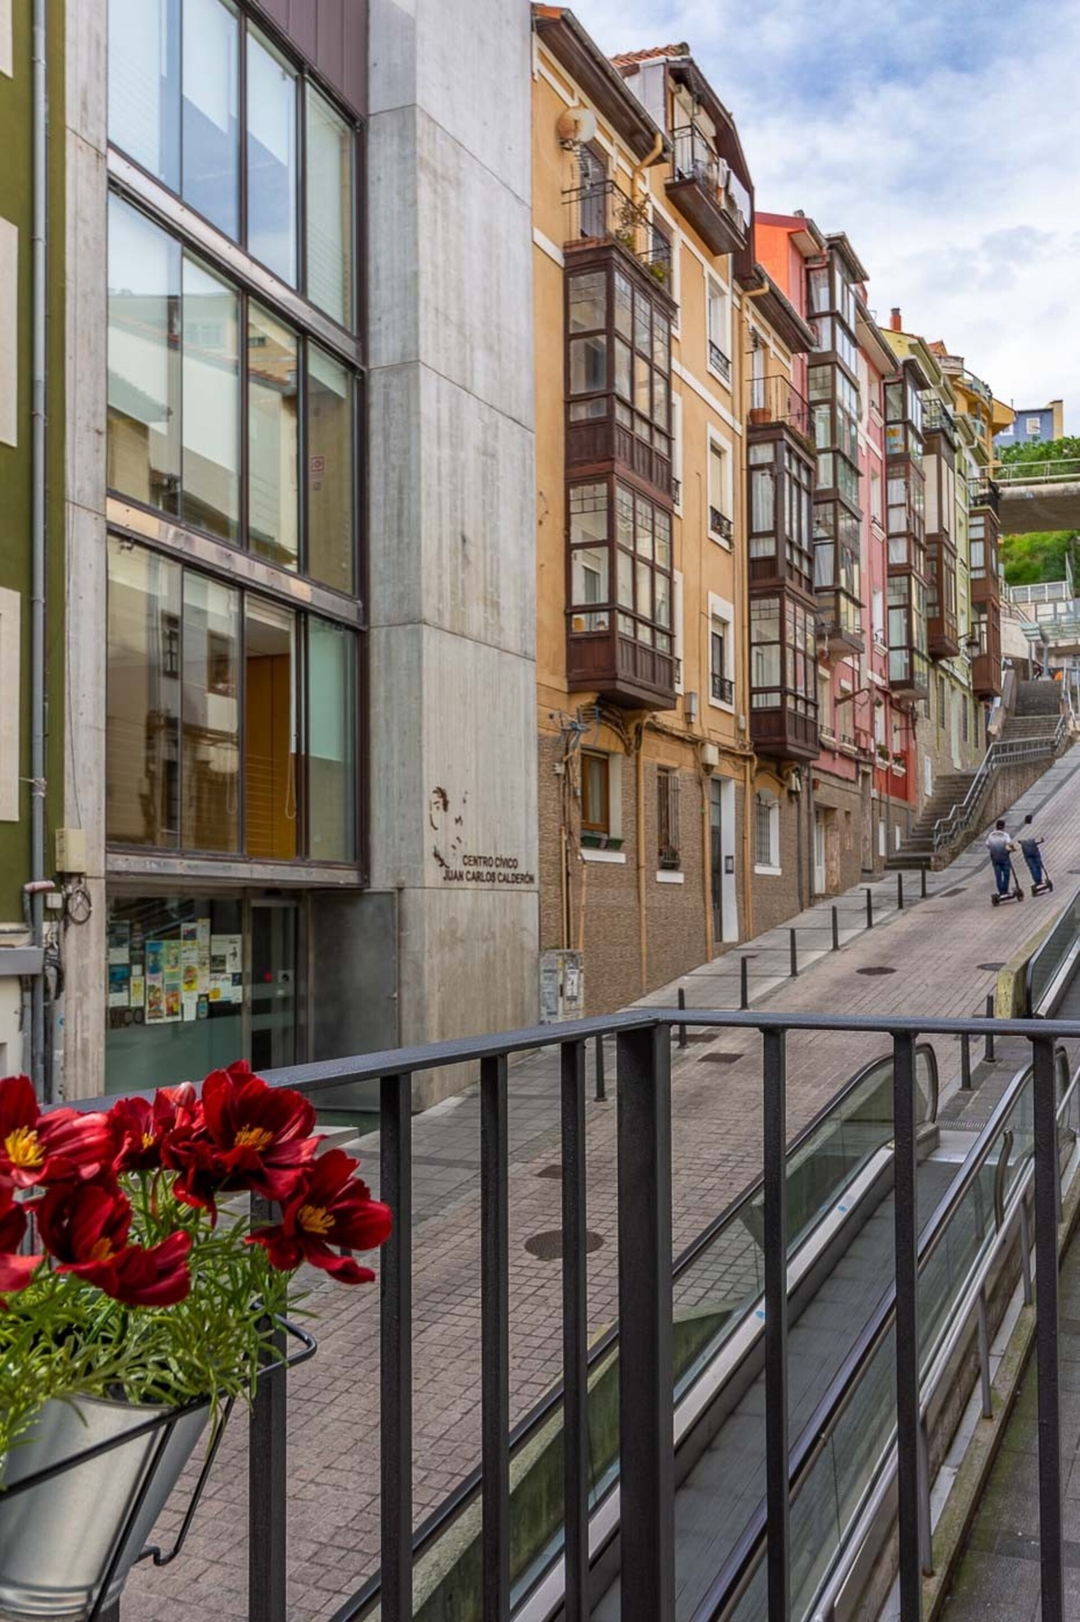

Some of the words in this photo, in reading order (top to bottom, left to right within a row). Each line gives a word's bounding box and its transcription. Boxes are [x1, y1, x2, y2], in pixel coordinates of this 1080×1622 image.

[462, 854, 494, 867] CENTRO
[443, 869, 464, 881] JUAN
[465, 870, 496, 883] CARLOS
[497, 870, 535, 884] CALDERÓN
